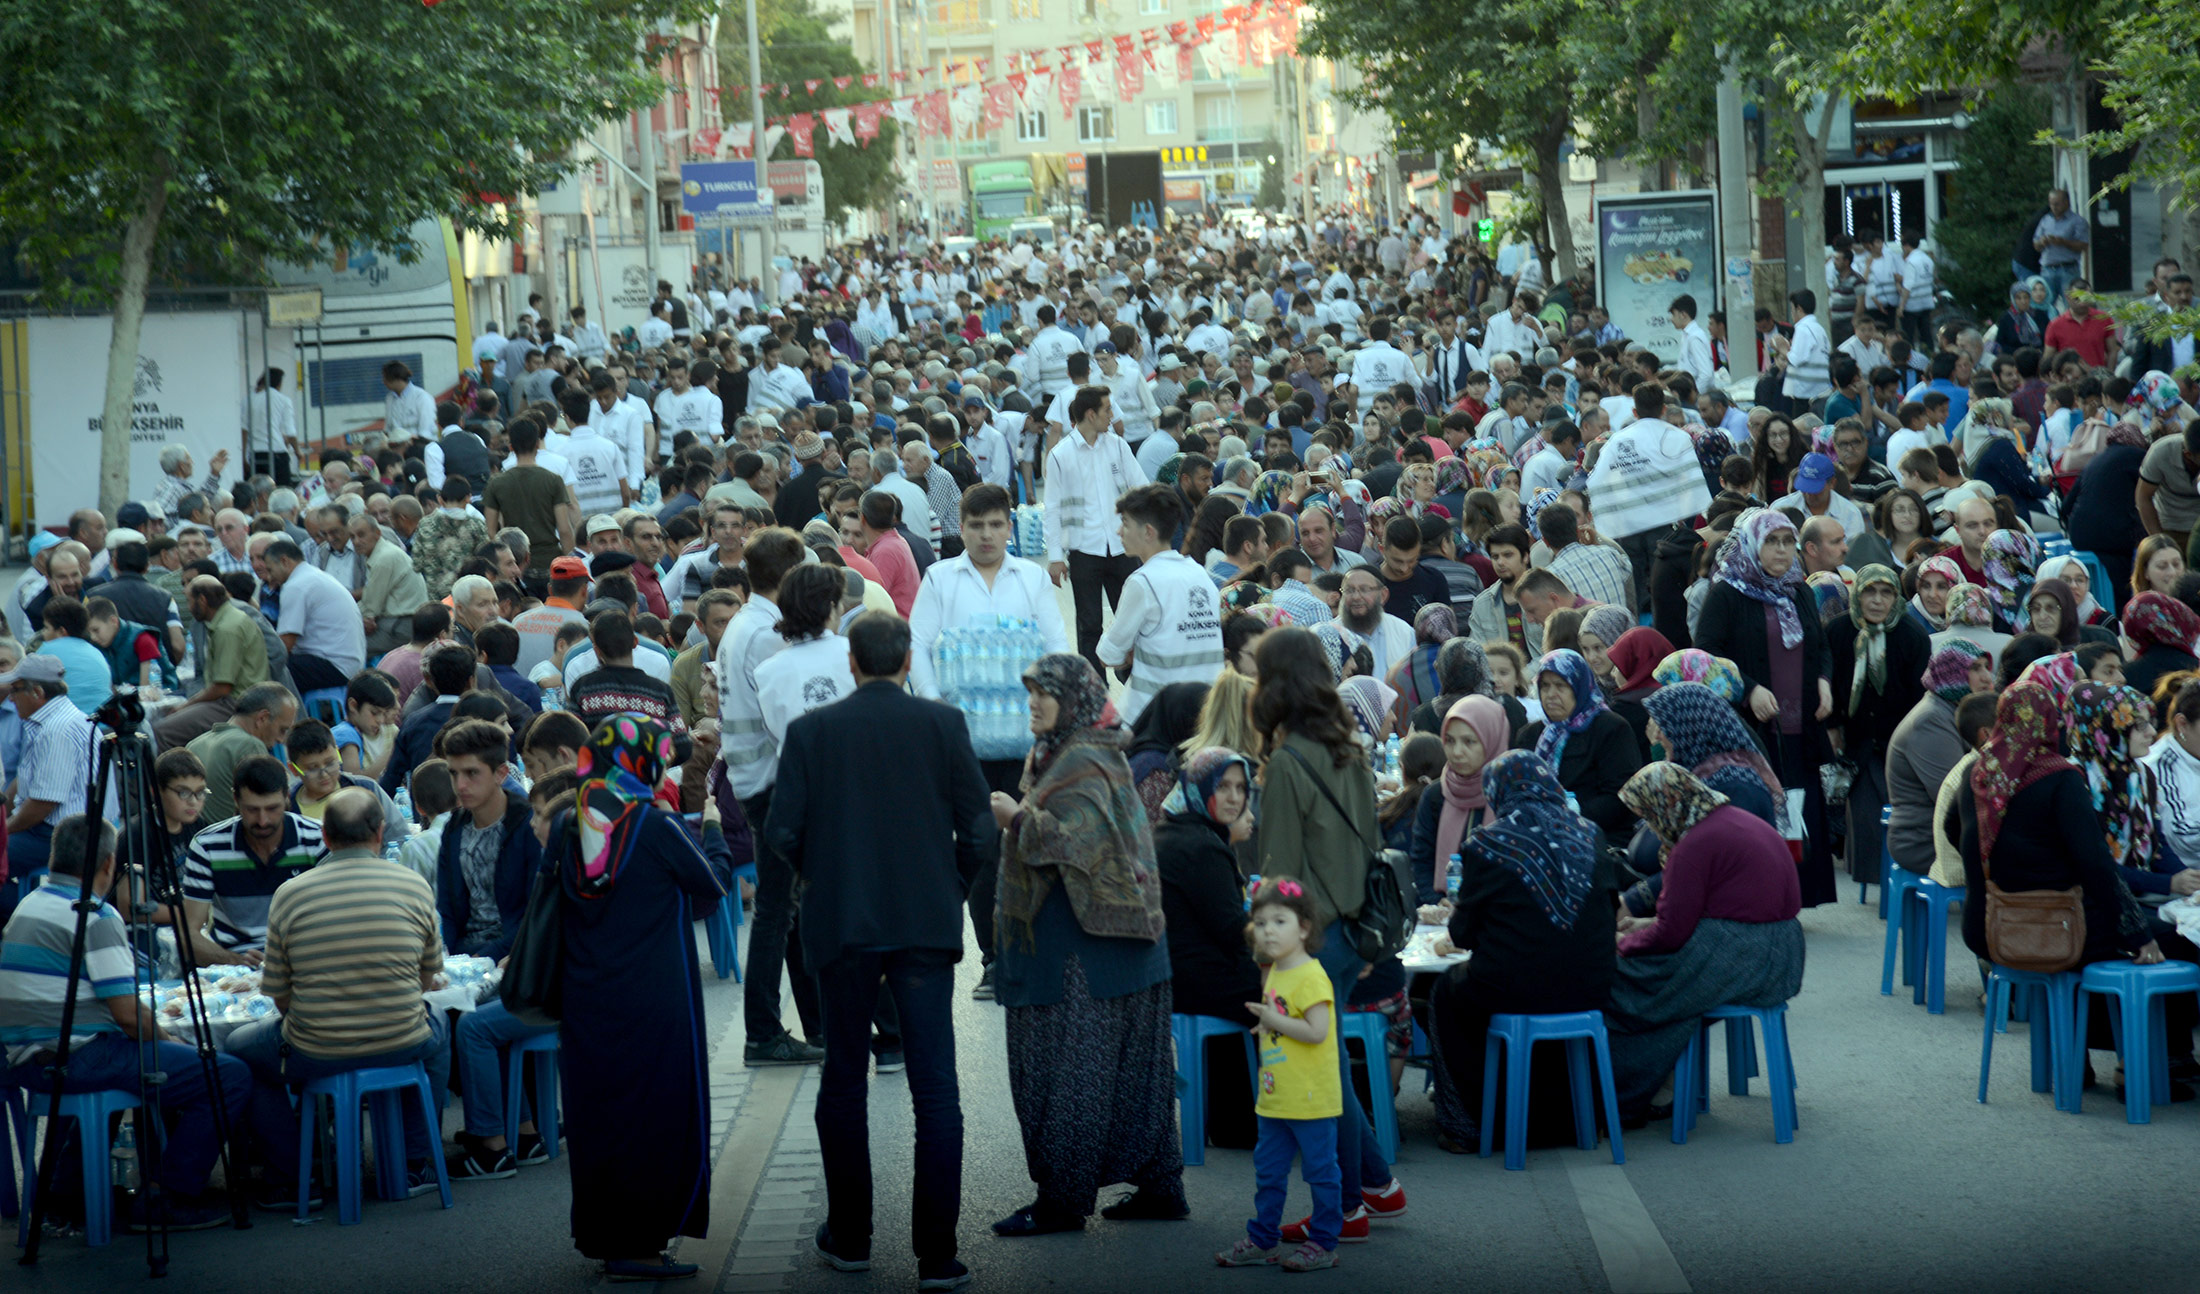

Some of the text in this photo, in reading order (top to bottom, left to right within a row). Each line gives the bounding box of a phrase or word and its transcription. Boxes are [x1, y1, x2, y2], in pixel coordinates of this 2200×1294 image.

[702, 181, 757, 192] TURKCELL
[131, 402, 160, 414] NYA
[1188, 609, 1214, 618] KONYA
